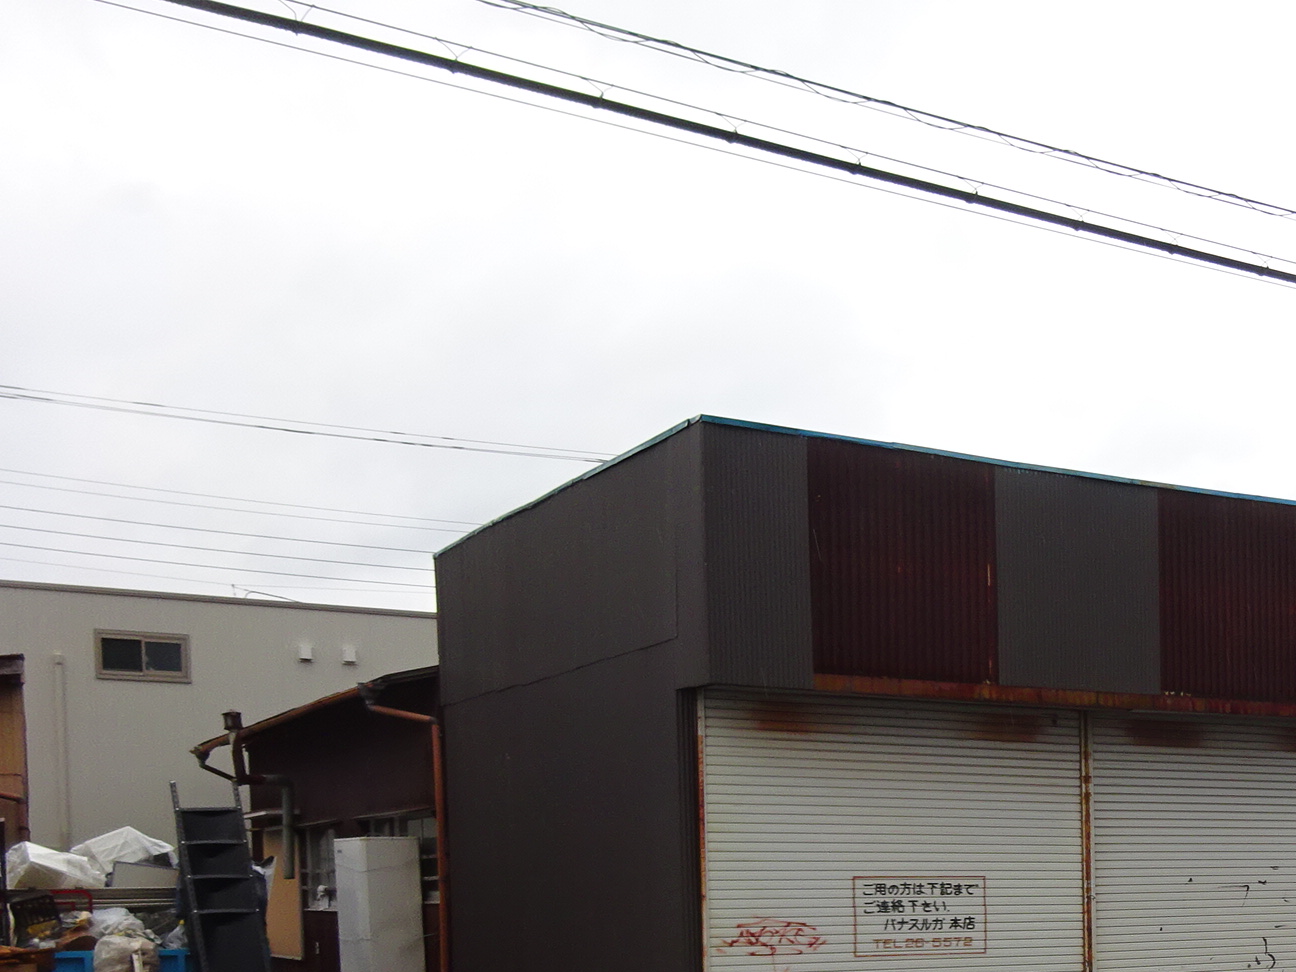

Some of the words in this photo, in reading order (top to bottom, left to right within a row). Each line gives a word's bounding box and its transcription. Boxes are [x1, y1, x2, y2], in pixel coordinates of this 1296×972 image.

[863, 882, 979, 896] ご用の方は下記まで
[949, 916, 976, 930] 本店
